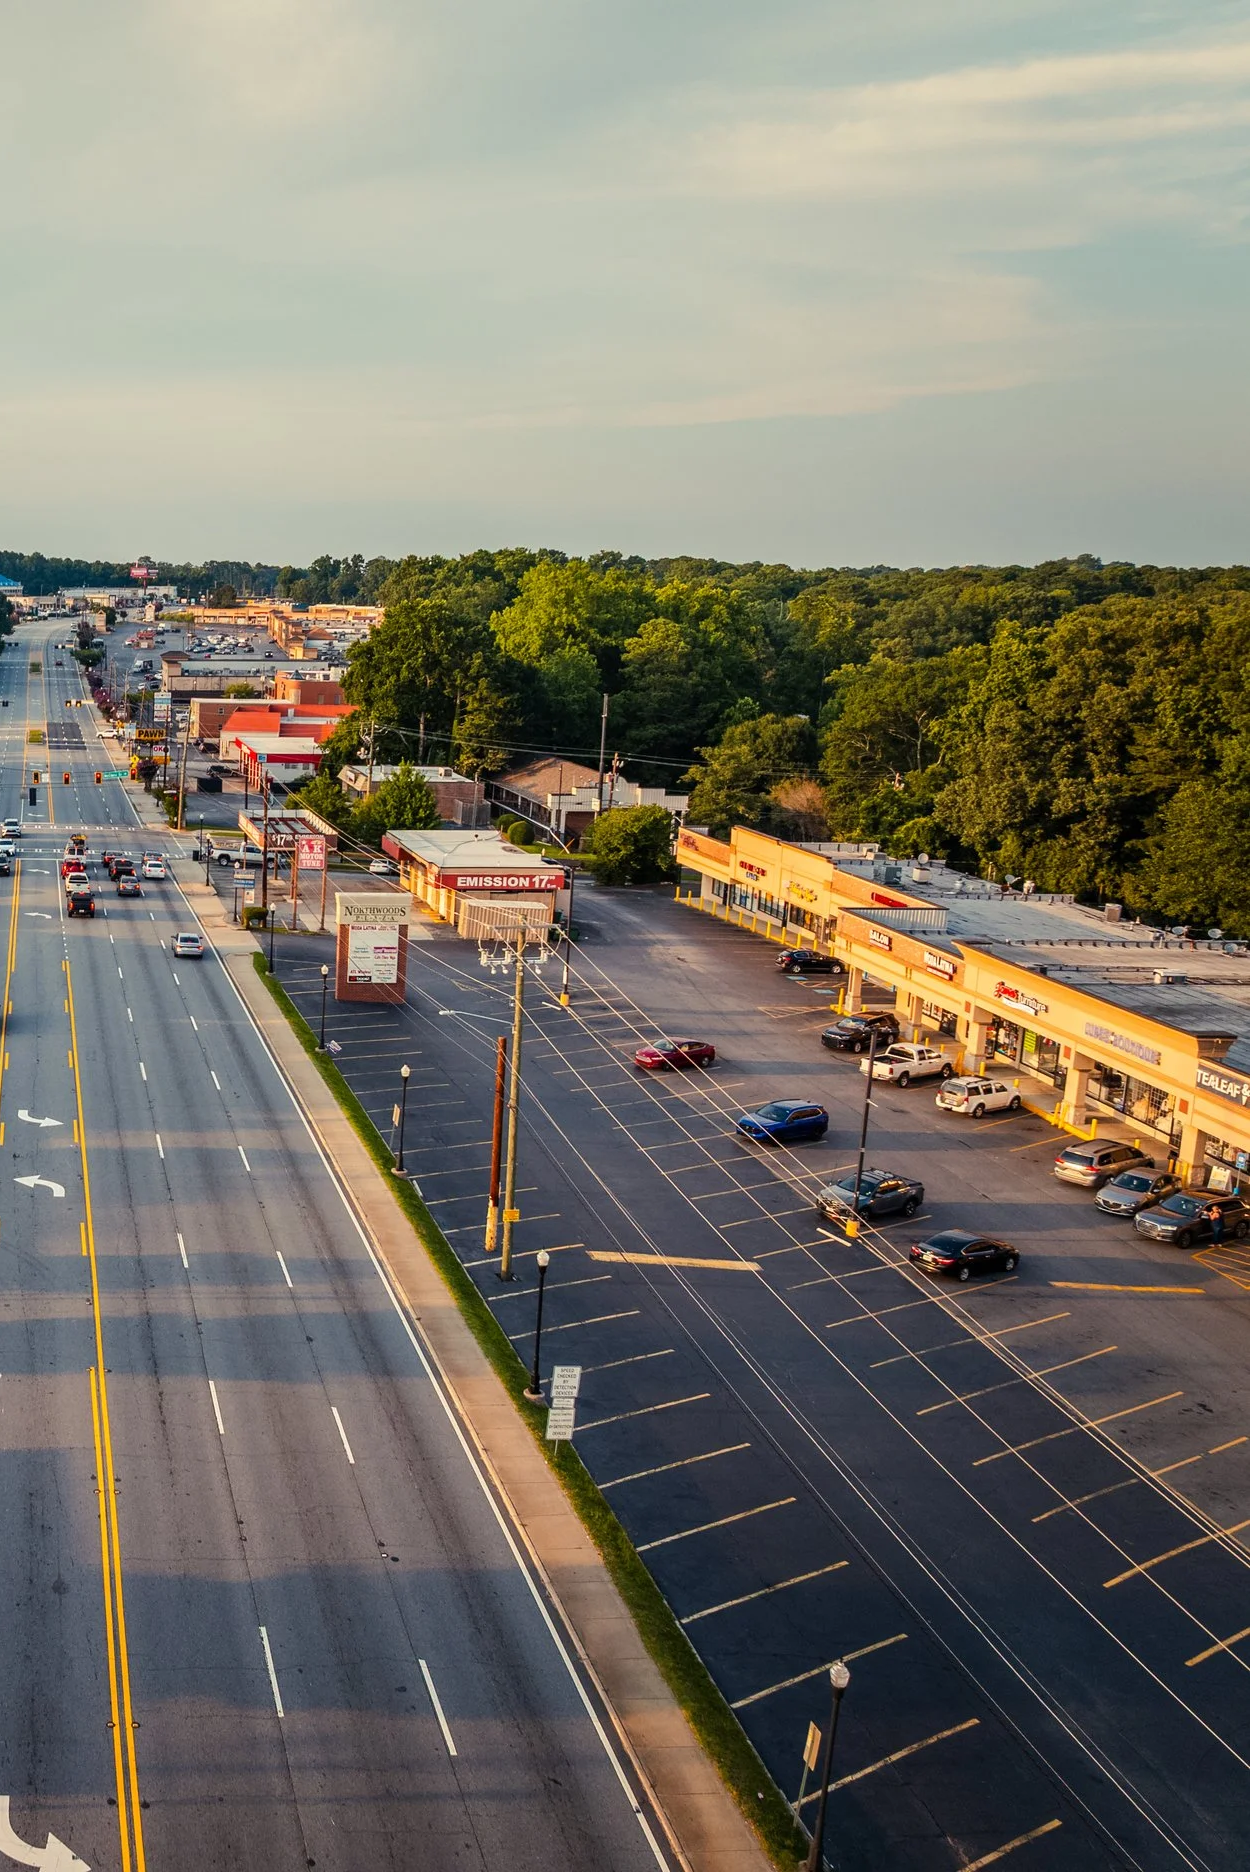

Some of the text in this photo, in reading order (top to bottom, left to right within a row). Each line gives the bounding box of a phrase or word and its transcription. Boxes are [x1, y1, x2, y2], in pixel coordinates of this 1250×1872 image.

[302, 844, 323, 853] A K
[457, 876, 530, 887] EMISSION
[345, 906, 406, 917] NORTHWOODS
